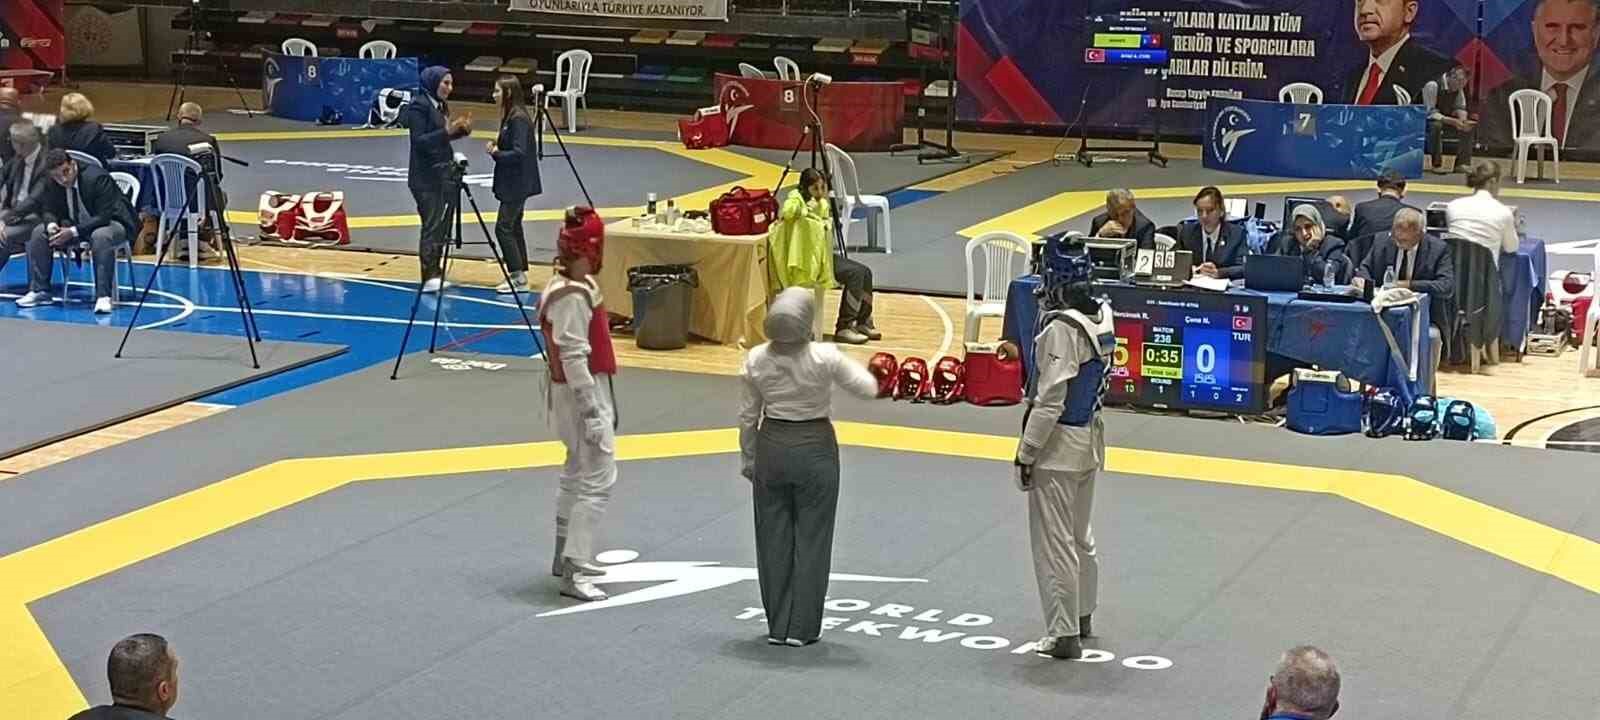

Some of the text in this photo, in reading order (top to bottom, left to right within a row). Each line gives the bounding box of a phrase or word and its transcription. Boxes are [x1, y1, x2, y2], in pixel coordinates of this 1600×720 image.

[1218, 13, 1270, 31] KATILAN
[1273, 12, 1302, 32] TÜM
[1216, 36, 1232, 53] VE
[1234, 37, 1315, 57] SPORCULARA
[307, 65, 317, 78] 8
[1212, 57, 1267, 79] DİLERİM.
[784, 89, 794, 103] 8
[1299, 113, 1311, 128] 7
[1232, 332, 1251, 342] TUR
[1146, 348, 1179, 363] 0:35
[1196, 343, 1215, 374] 0
[1236, 393, 1242, 402] 2
[824, 596, 994, 627] ORLD
[735, 607, 1173, 670] TEKWODO
